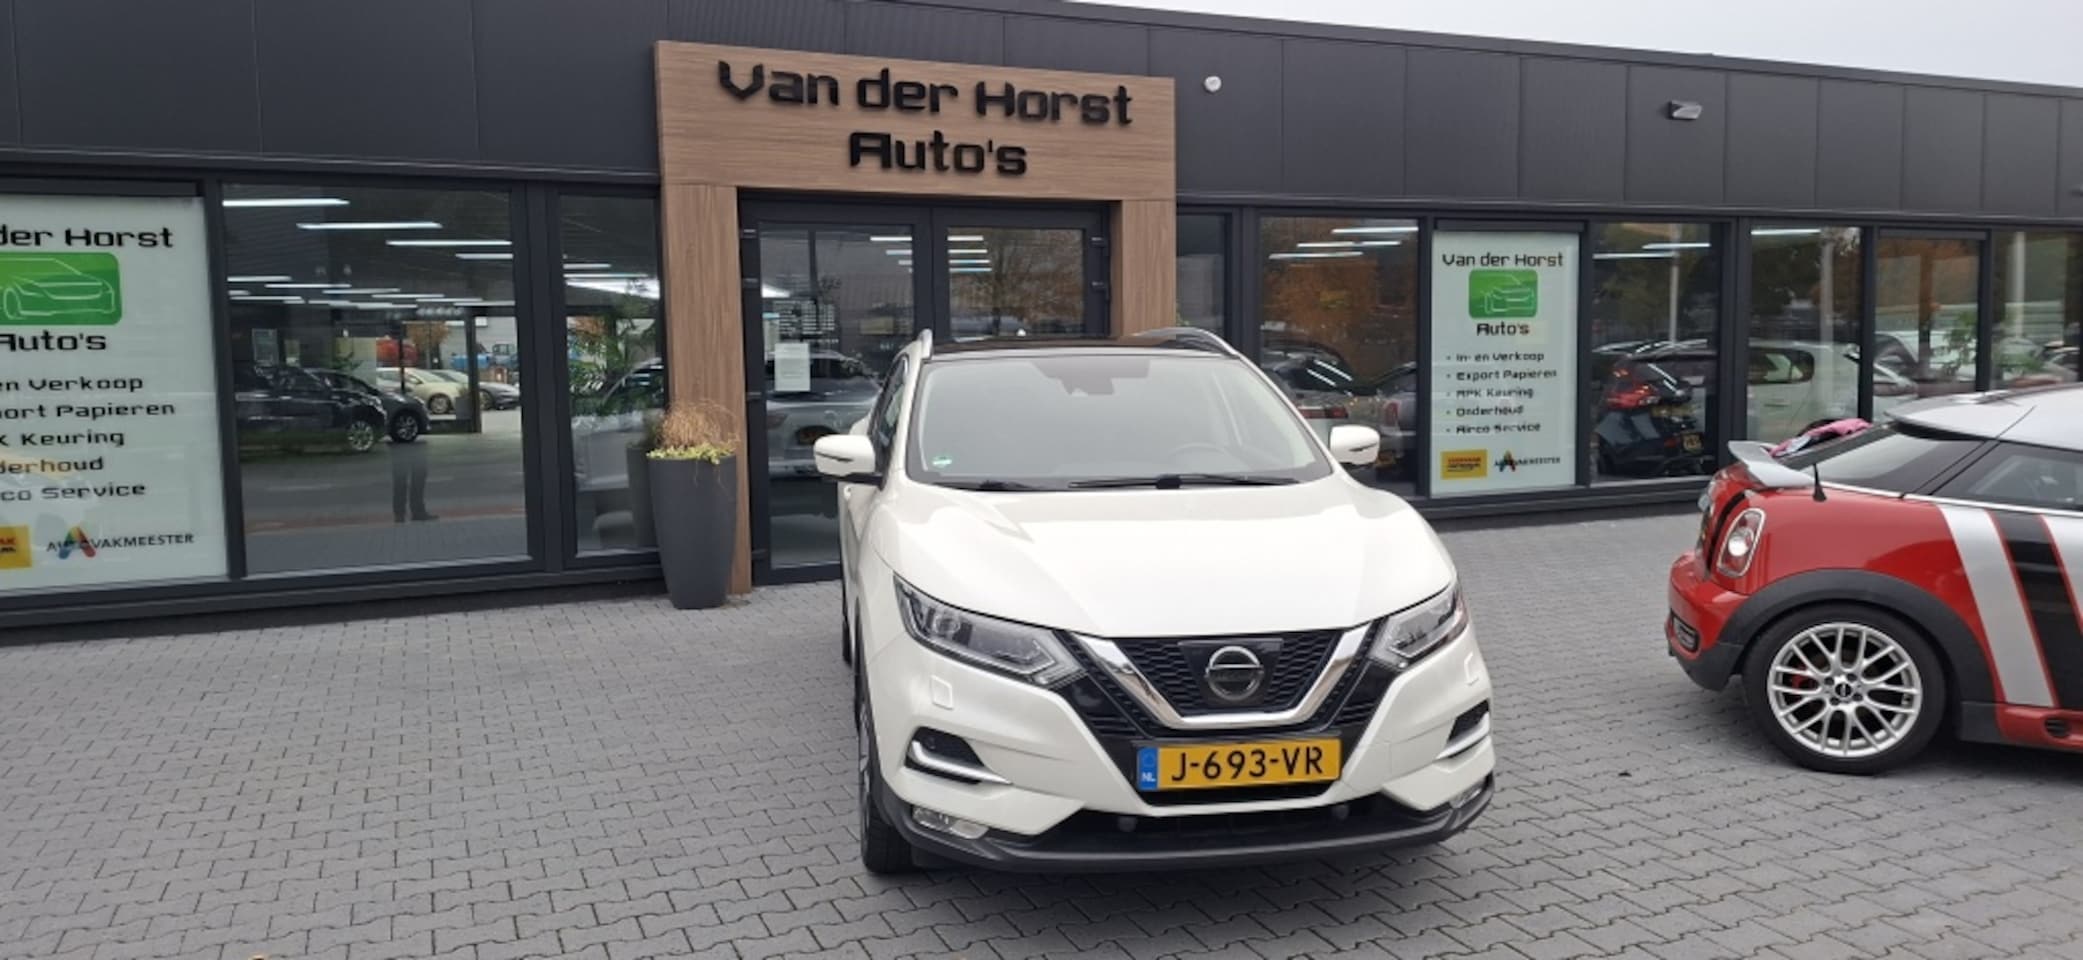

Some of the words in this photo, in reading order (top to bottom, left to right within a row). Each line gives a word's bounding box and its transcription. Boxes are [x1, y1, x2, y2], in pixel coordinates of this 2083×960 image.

[718, 60, 839, 107] Van
[856, 68, 959, 114] der
[975, 81, 1133, 126] Horst
[849, 130, 1027, 176] Auto's
[64, 227, 173, 248] Horst
[1442, 253, 1476, 267] Van
[1480, 252, 1510, 266] der
[1514, 253, 1564, 267] Horst
[1476, 321, 1531, 336] Auto's
[1474, 353, 1490, 362] en
[1492, 351, 1545, 363] Verkoop
[28, 376, 144, 393] Verkoop
[0, 404, 47, 420] ort
[56, 402, 175, 420] Papieren
[21, 429, 125, 448] Keuring
[41, 482, 146, 500] Service
[1142, 772, 1156, 782] NL
[1171, 746, 1324, 782] J-693-VR
